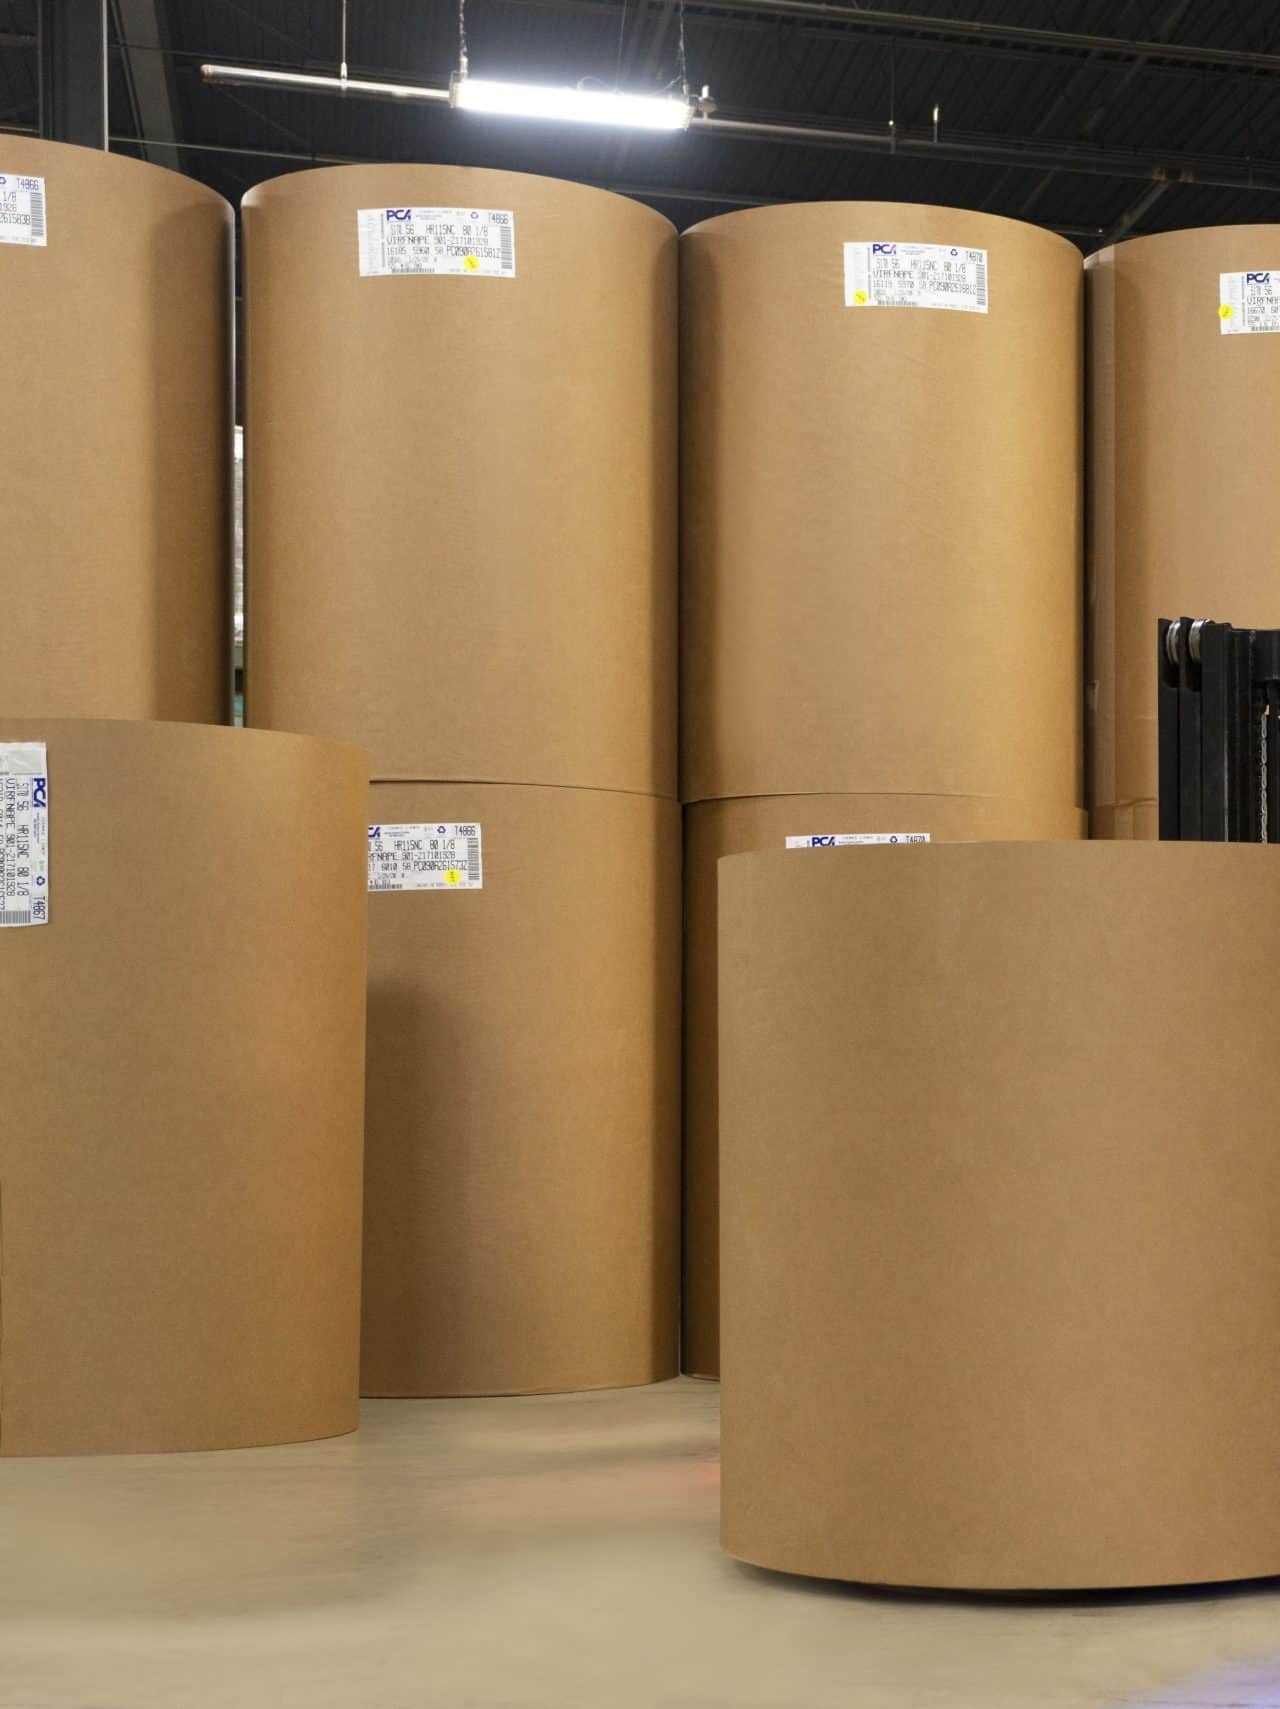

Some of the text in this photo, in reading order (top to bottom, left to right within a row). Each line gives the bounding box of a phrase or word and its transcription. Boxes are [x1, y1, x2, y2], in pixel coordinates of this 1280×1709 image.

[386, 209, 411, 221] PCA
[872, 244, 896, 255] PCA
[1247, 273, 1269, 284] PCA
[33, 778, 46, 808] PCA
[368, 826, 380, 838] CA
[812, 836, 835, 847] PCA
[17, 881, 29, 896] 1/8
